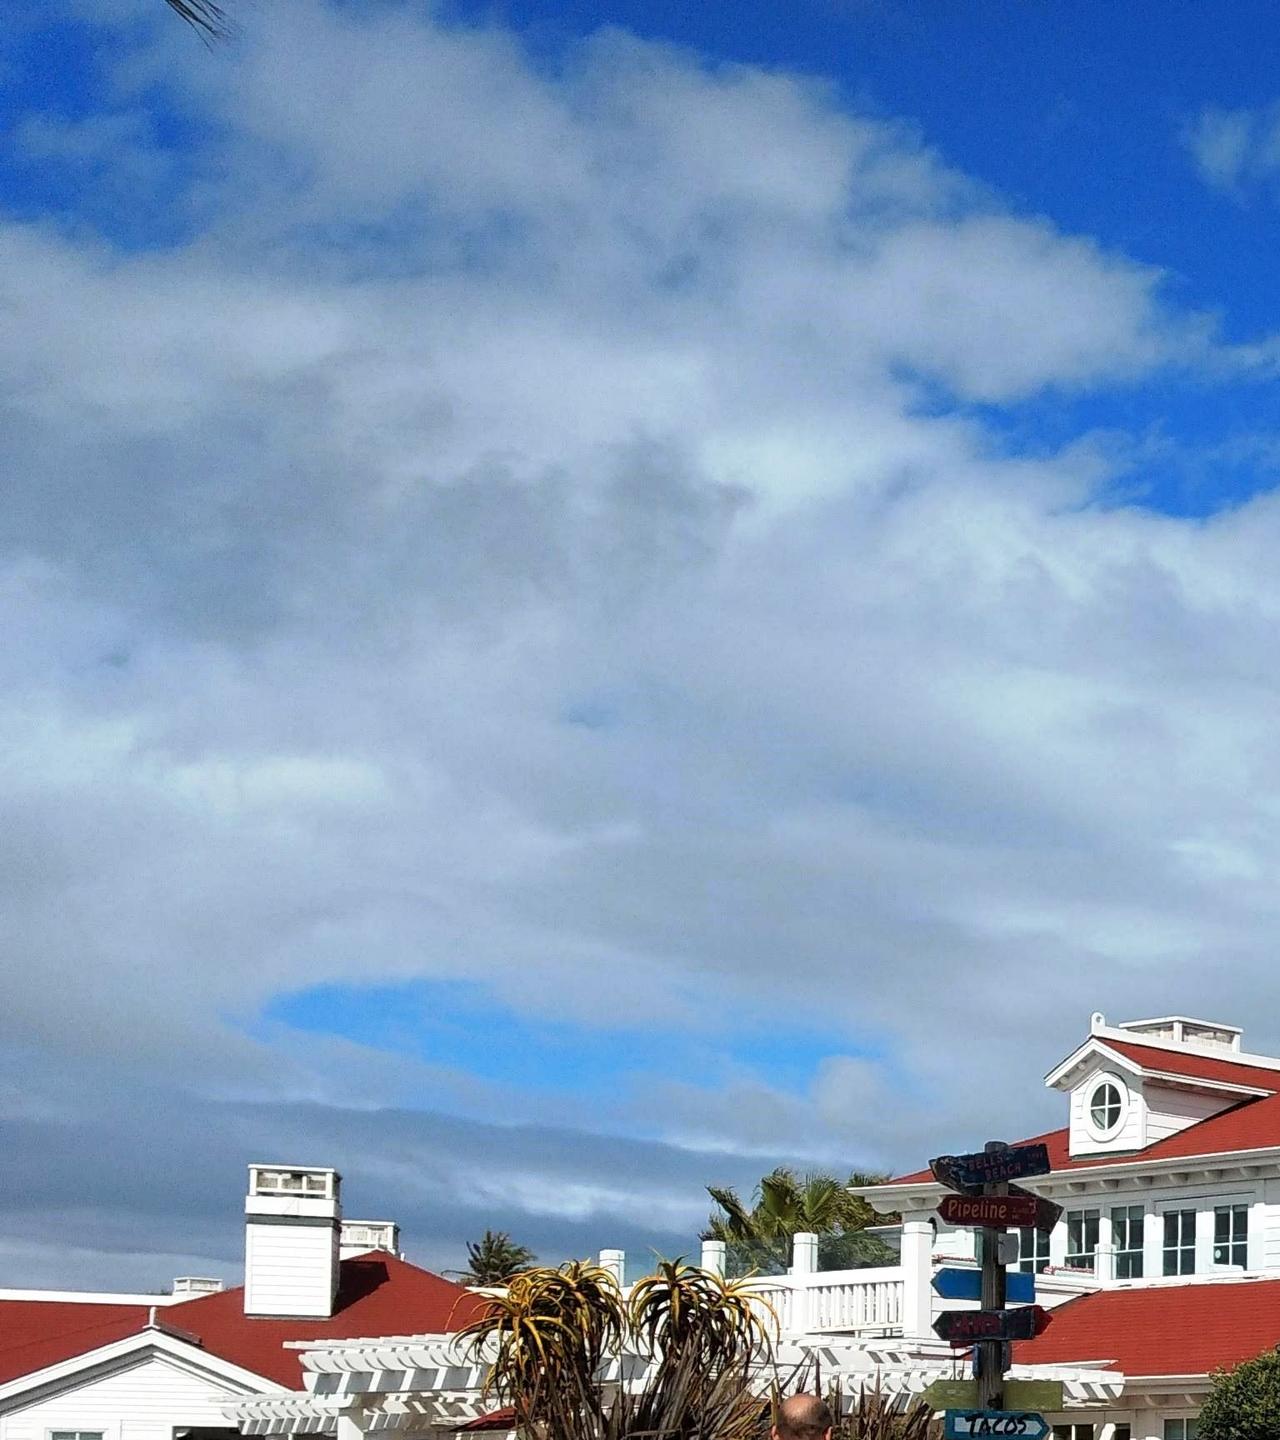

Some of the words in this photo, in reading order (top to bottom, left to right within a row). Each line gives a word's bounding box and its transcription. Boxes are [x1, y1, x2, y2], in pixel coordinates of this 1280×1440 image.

[984, 1162, 1021, 1180] BEACH
[947, 1199, 1008, 1219] Pipeline
[965, 1413, 1027, 1438] TACOS
